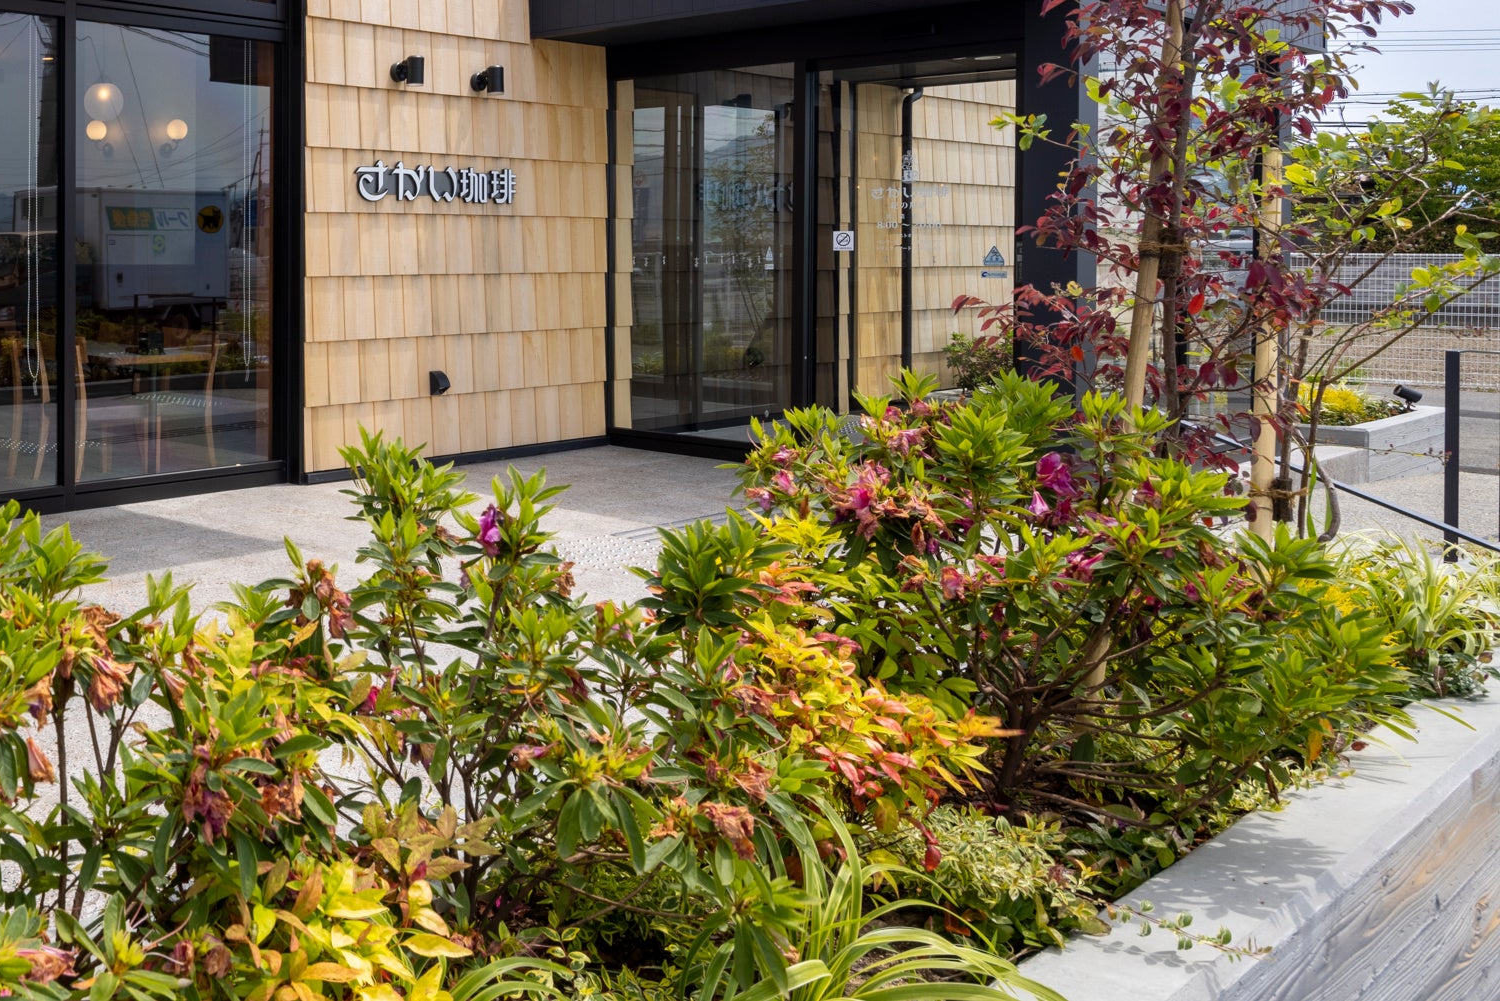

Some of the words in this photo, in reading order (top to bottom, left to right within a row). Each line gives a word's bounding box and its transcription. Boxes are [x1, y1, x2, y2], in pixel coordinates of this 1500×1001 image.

[355, 160, 516, 204] さかい珈琲
